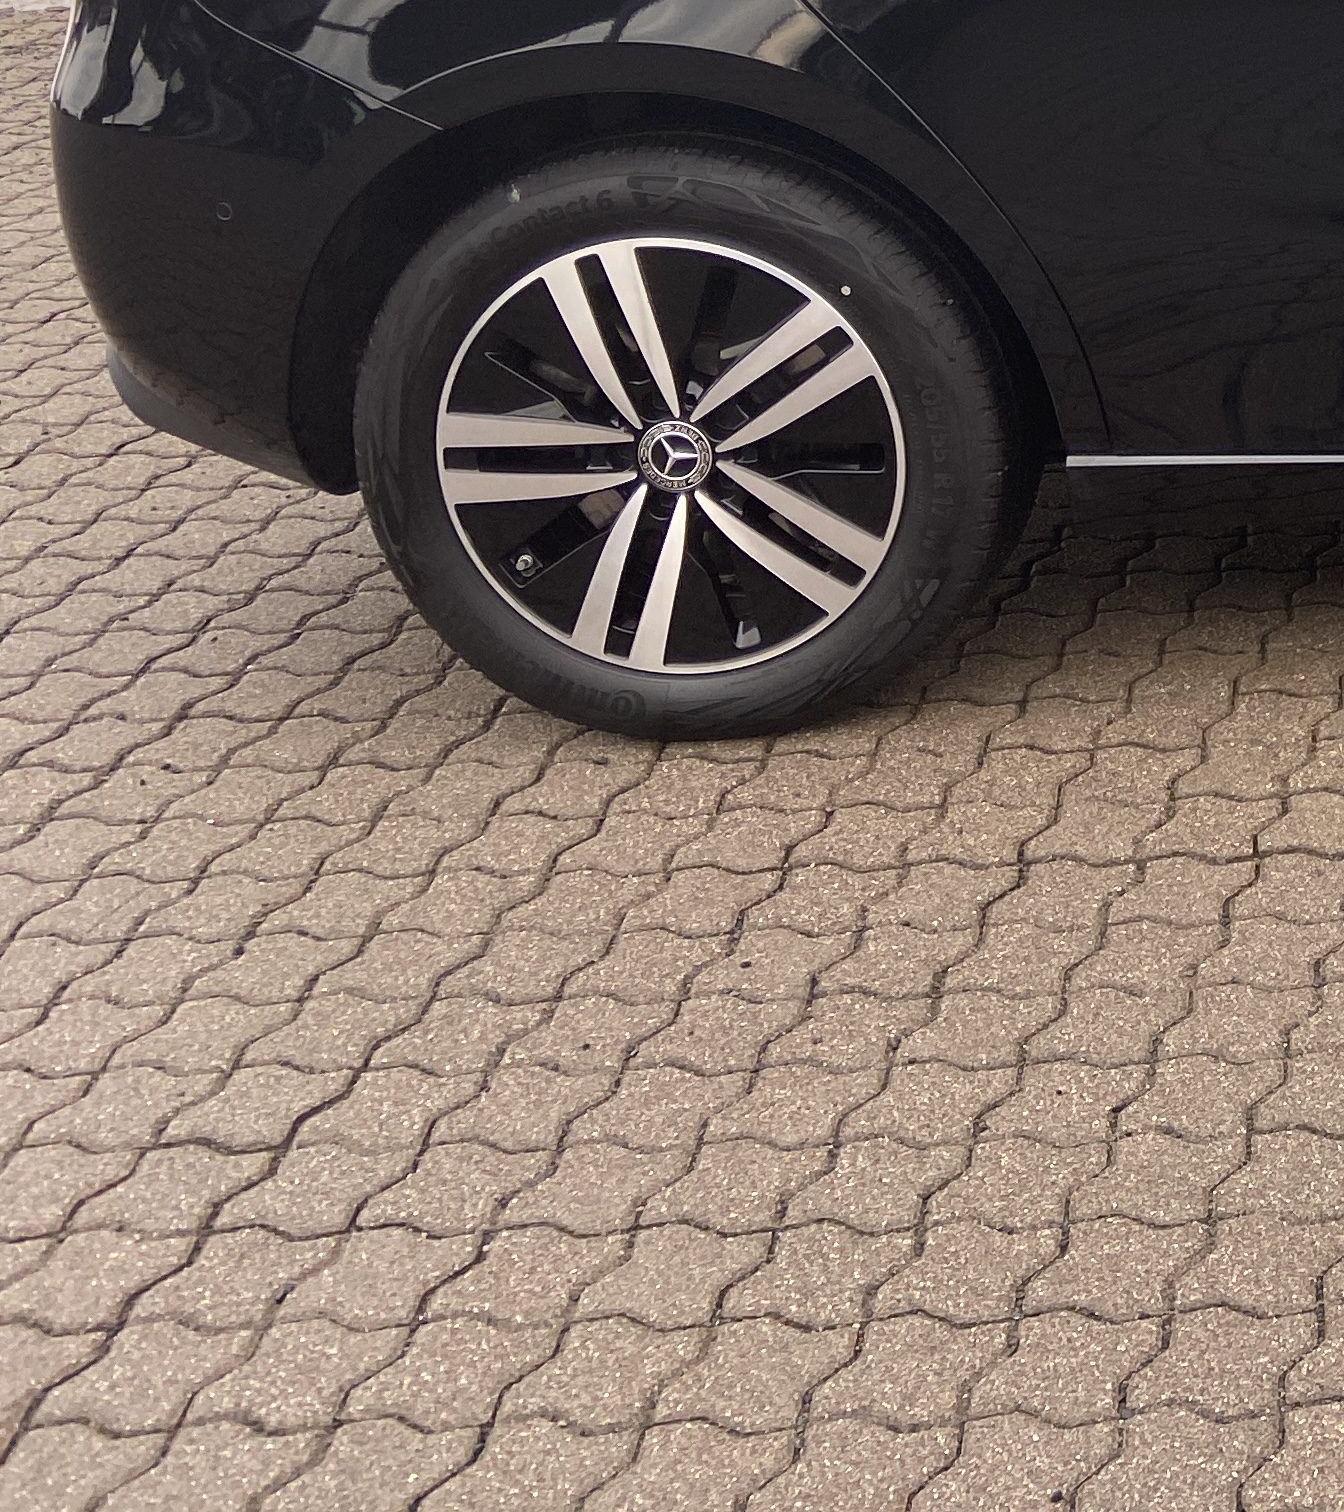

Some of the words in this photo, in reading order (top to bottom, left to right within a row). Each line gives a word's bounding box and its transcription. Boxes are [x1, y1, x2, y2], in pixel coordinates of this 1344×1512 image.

[913, 372, 949, 463] 205/55
[674, 424, 700, 441] BENZ
[642, 461, 687, 488] MERCEDES
[930, 494, 954, 519] 17
